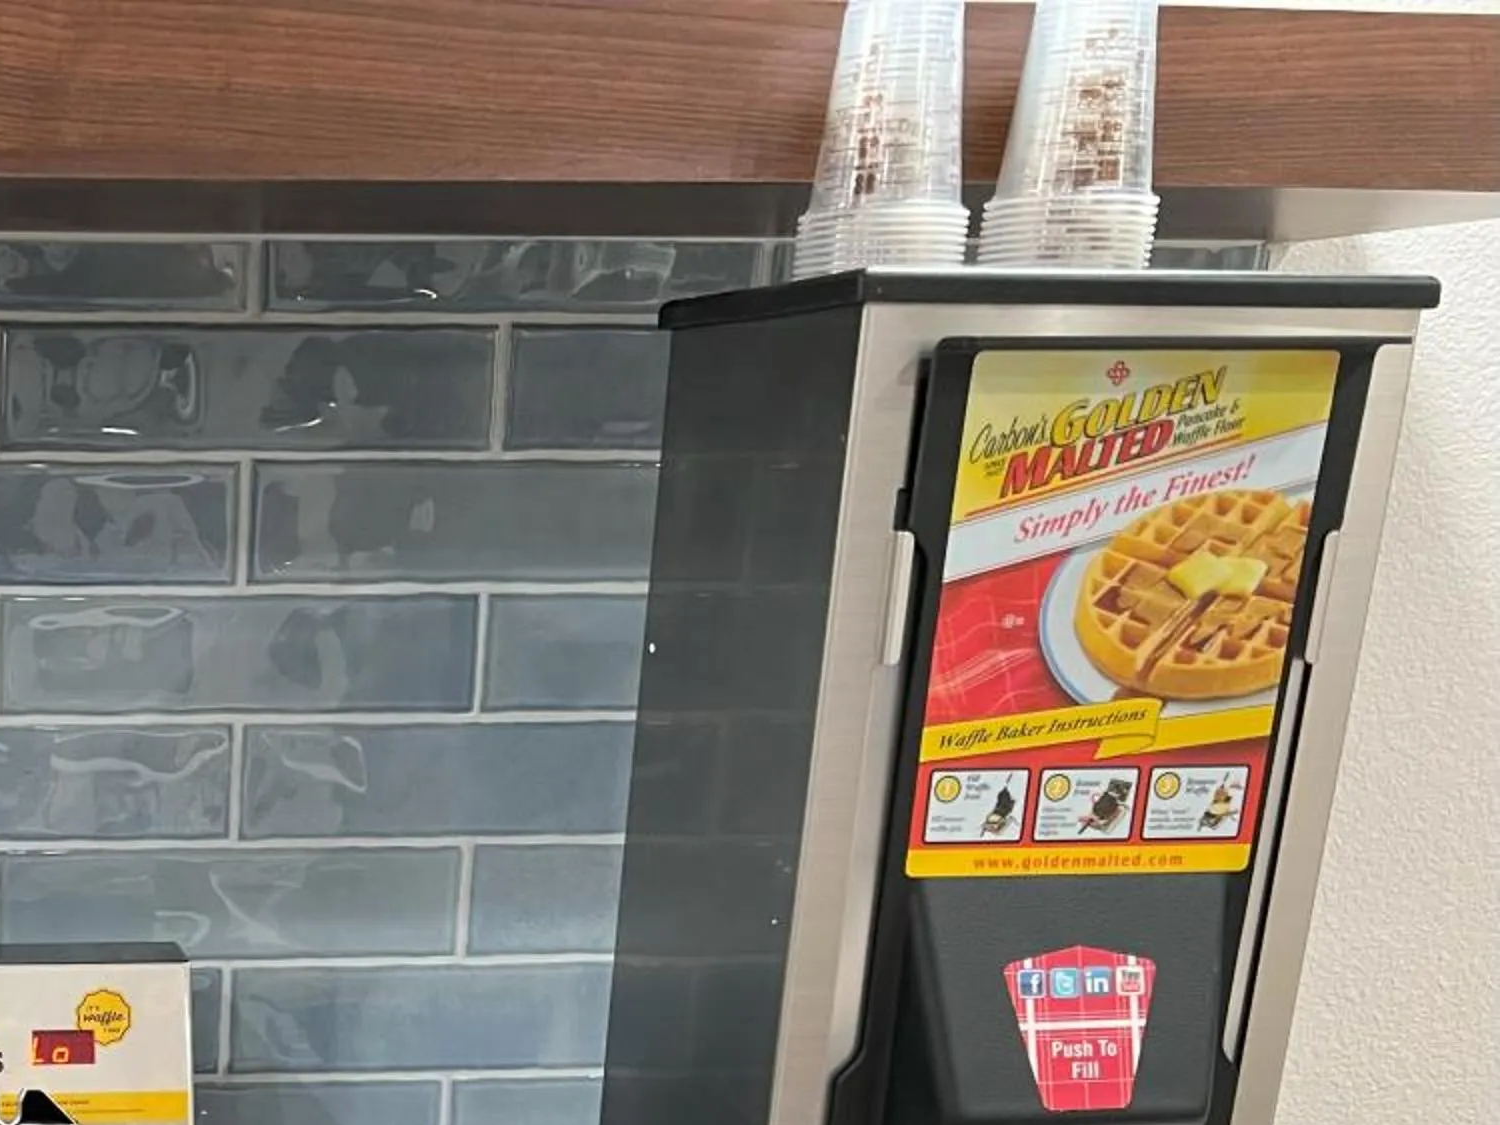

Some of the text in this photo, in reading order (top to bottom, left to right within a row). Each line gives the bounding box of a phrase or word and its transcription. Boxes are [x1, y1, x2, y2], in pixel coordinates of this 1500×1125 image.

[1050, 365, 1229, 448] GOLDEN
[1000, 418, 1175, 498] MALTED
[1014, 453, 1257, 543] Simply the Finest!
[940, 708, 1148, 750] Waffle Baker Instructions
[972, 854, 1184, 871] www.goldenmalted.com
[1051, 1039, 1118, 1057] Push To
[1072, 1061, 1099, 1079] Fill
